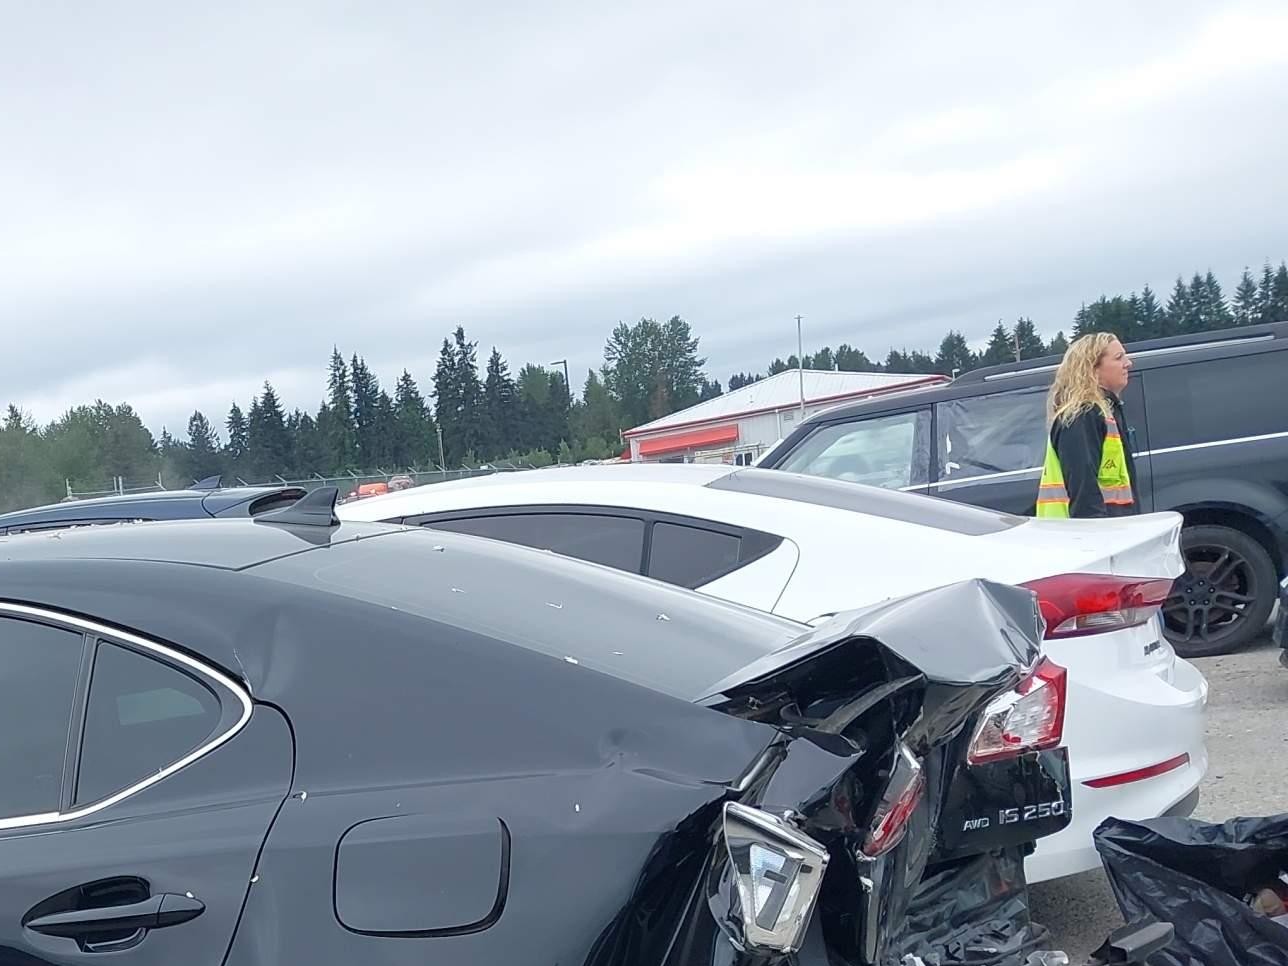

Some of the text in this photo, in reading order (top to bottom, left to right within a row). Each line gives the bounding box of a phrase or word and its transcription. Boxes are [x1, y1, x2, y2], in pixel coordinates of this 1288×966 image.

[963, 800, 1064, 832] AWD IS 250
